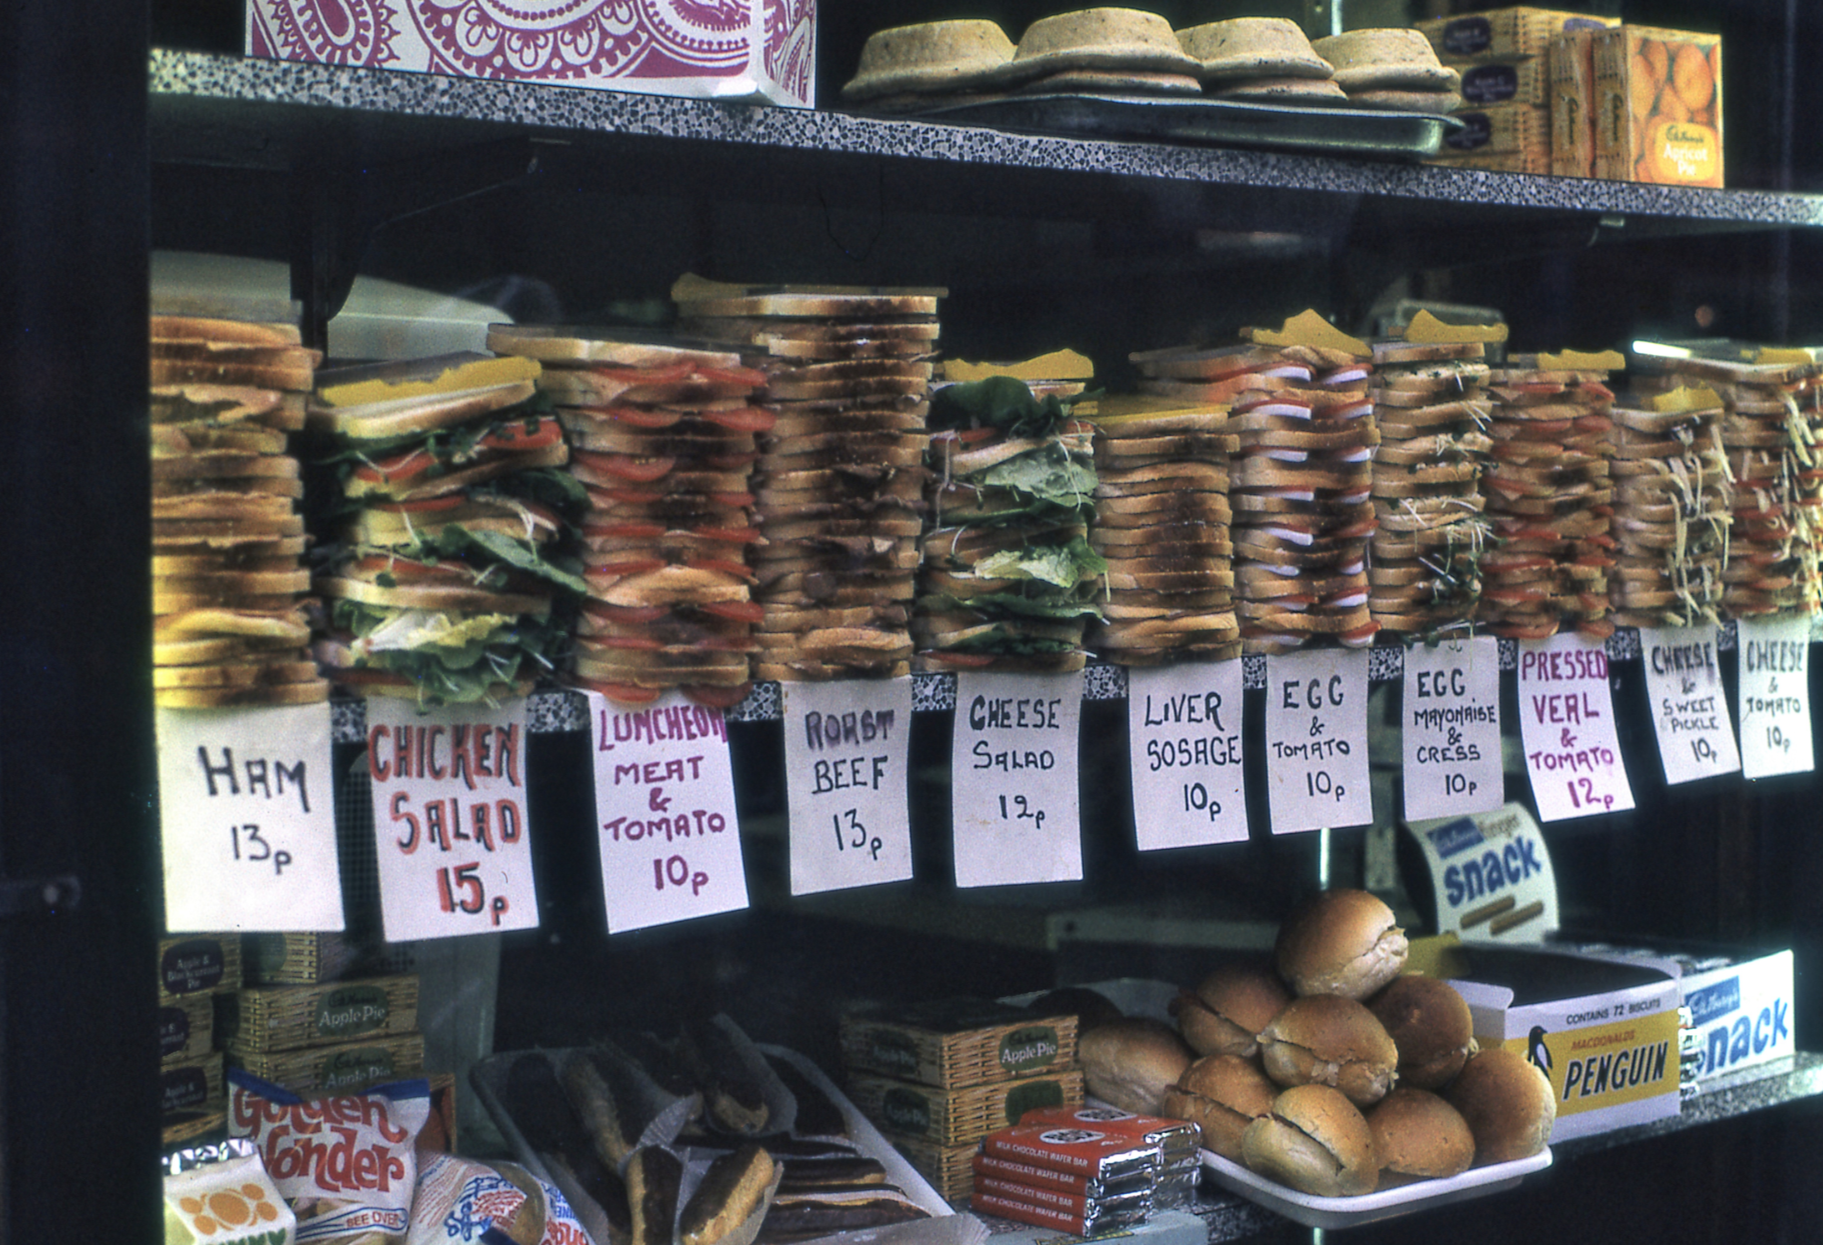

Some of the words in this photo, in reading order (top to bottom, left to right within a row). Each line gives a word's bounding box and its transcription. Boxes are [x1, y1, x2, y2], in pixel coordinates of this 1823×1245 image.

[1663, 143, 1708, 162] Apricot
[1678, 160, 1695, 176] Pie
[1522, 649, 1609, 682] PRESSED
[1651, 641, 1715, 675] CHEESE
[1746, 640, 1804, 673] CHEESE
[1282, 674, 1344, 710] EGG
[1417, 668, 1466, 698] EGG
[1681, 676, 1696, 695] &
[1768, 676, 1778, 693] &
[969, 694, 1061, 731] CHEESE
[1144, 691, 1225, 732] LIVER
[1532, 691, 1600, 725] VEAL
[1662, 697, 1716, 716] SWEET
[1746, 697, 1801, 716] TOMATO
[599, 704, 728, 751] LUNCHEON
[805, 709, 895, 750] ROAST
[1309, 715, 1325, 737] &
[1447, 726, 1463, 746] &
[1560, 728, 1577, 748] &
[1766, 726, 1790, 753] 10p
[367, 722, 522, 790] CHICKEN
[973, 740, 1055, 772] SALAD
[1147, 735, 1242, 771] SOSAGE
[1273, 738, 1351, 760] TOMATO
[1417, 744, 1481, 764] CRESS
[1529, 747, 1614, 773] TOMATO
[1690, 738, 1718, 763] 10p
[198, 745, 311, 813] HAM
[614, 755, 704, 785] MEAT
[811, 755, 889, 795] BEEF
[1445, 773, 1477, 796] 10p
[649, 787, 672, 813] &
[1183, 782, 1222, 821] 10p
[1306, 771, 1345, 802] 10p
[1567, 778, 1614, 810] 12p
[390, 791, 522, 855] SALAD
[603, 810, 726, 842] TOMATO
[999, 794, 1045, 829] 12p
[232, 824, 292, 875] 13p
[833, 808, 882, 860] 13p
[653, 855, 709, 897] 10p
[1444, 836, 1541, 908] snack
[437, 861, 510, 926] 15p
[318, 1008, 361, 1029] Apple
[363, 1005, 386, 1022] Pie
[1566, 1007, 1610, 1024] CONTAINS
[1613, 1004, 1625, 1017] 72
[1628, 997, 1662, 1014] BISCUITS
[1001, 1046, 1036, 1064] Apple
[1037, 1042, 1057, 1057] Pie
[1562, 1040, 1669, 1100] PENGUIN
[1012, 1143, 1049, 1159] CHOCOLATE
[1049, 1152, 1072, 1164] WAFER
[1073, 1157, 1088, 1168] BAR
[999, 1160, 1036, 1175] CHOCOLATE
[1036, 1169, 1059, 1181] WAFER
[1059, 1173, 1075, 1184] BAR
[998, 1198, 1035, 1213] CHOCOLATE
[1035, 1206, 1058, 1219] WAFER
[1058, 1212, 1073, 1222] BAR
[999, 1181, 1035, 1198] CHOCOLATE
[1035, 1191, 1058, 1203] WAFER
[1058, 1197, 1073, 1208] BAR
